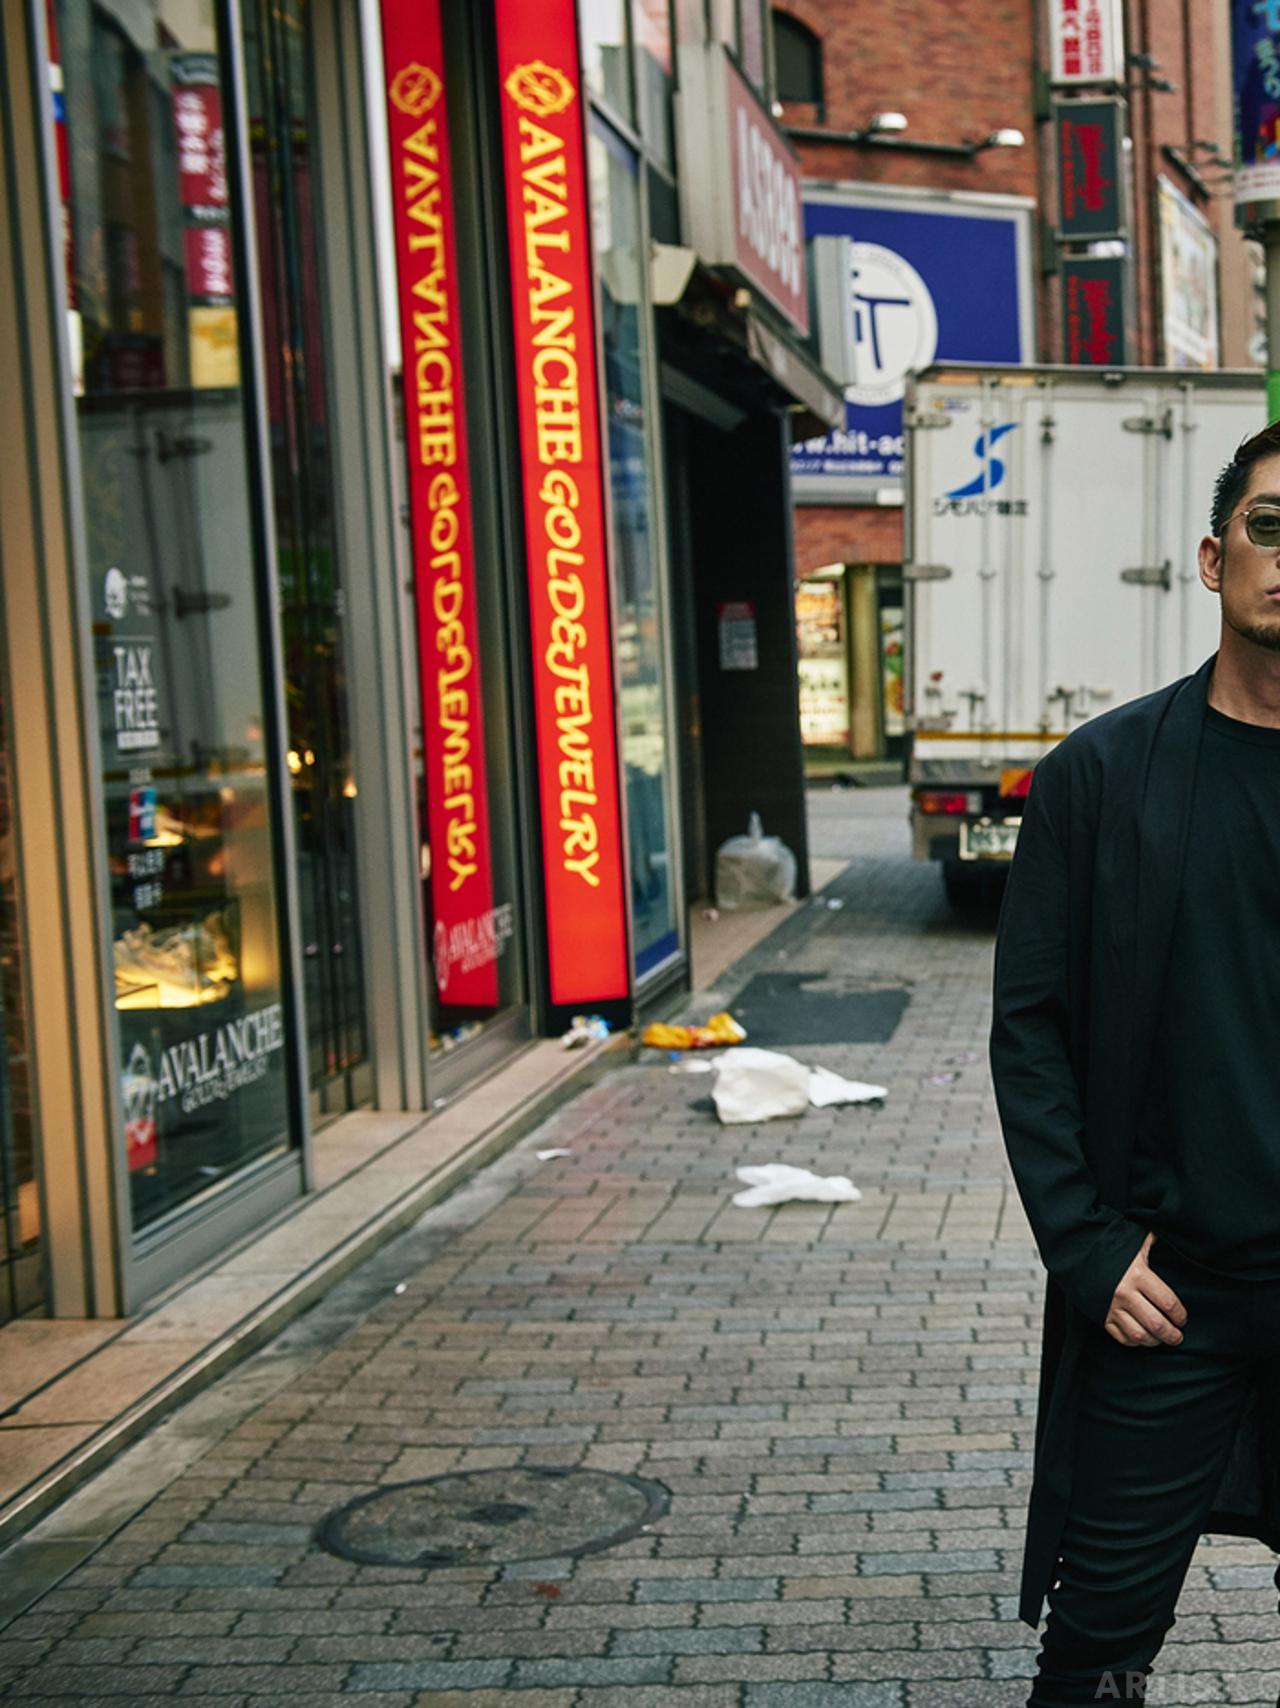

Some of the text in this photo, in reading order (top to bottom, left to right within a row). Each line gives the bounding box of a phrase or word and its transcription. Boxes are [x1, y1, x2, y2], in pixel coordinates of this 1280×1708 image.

[518, 117, 583, 466] AVALANCHE
[114, 646, 152, 687] TAX
[114, 687, 159, 730] FREE
[158, 1003, 284, 1102] AVALANCHE
